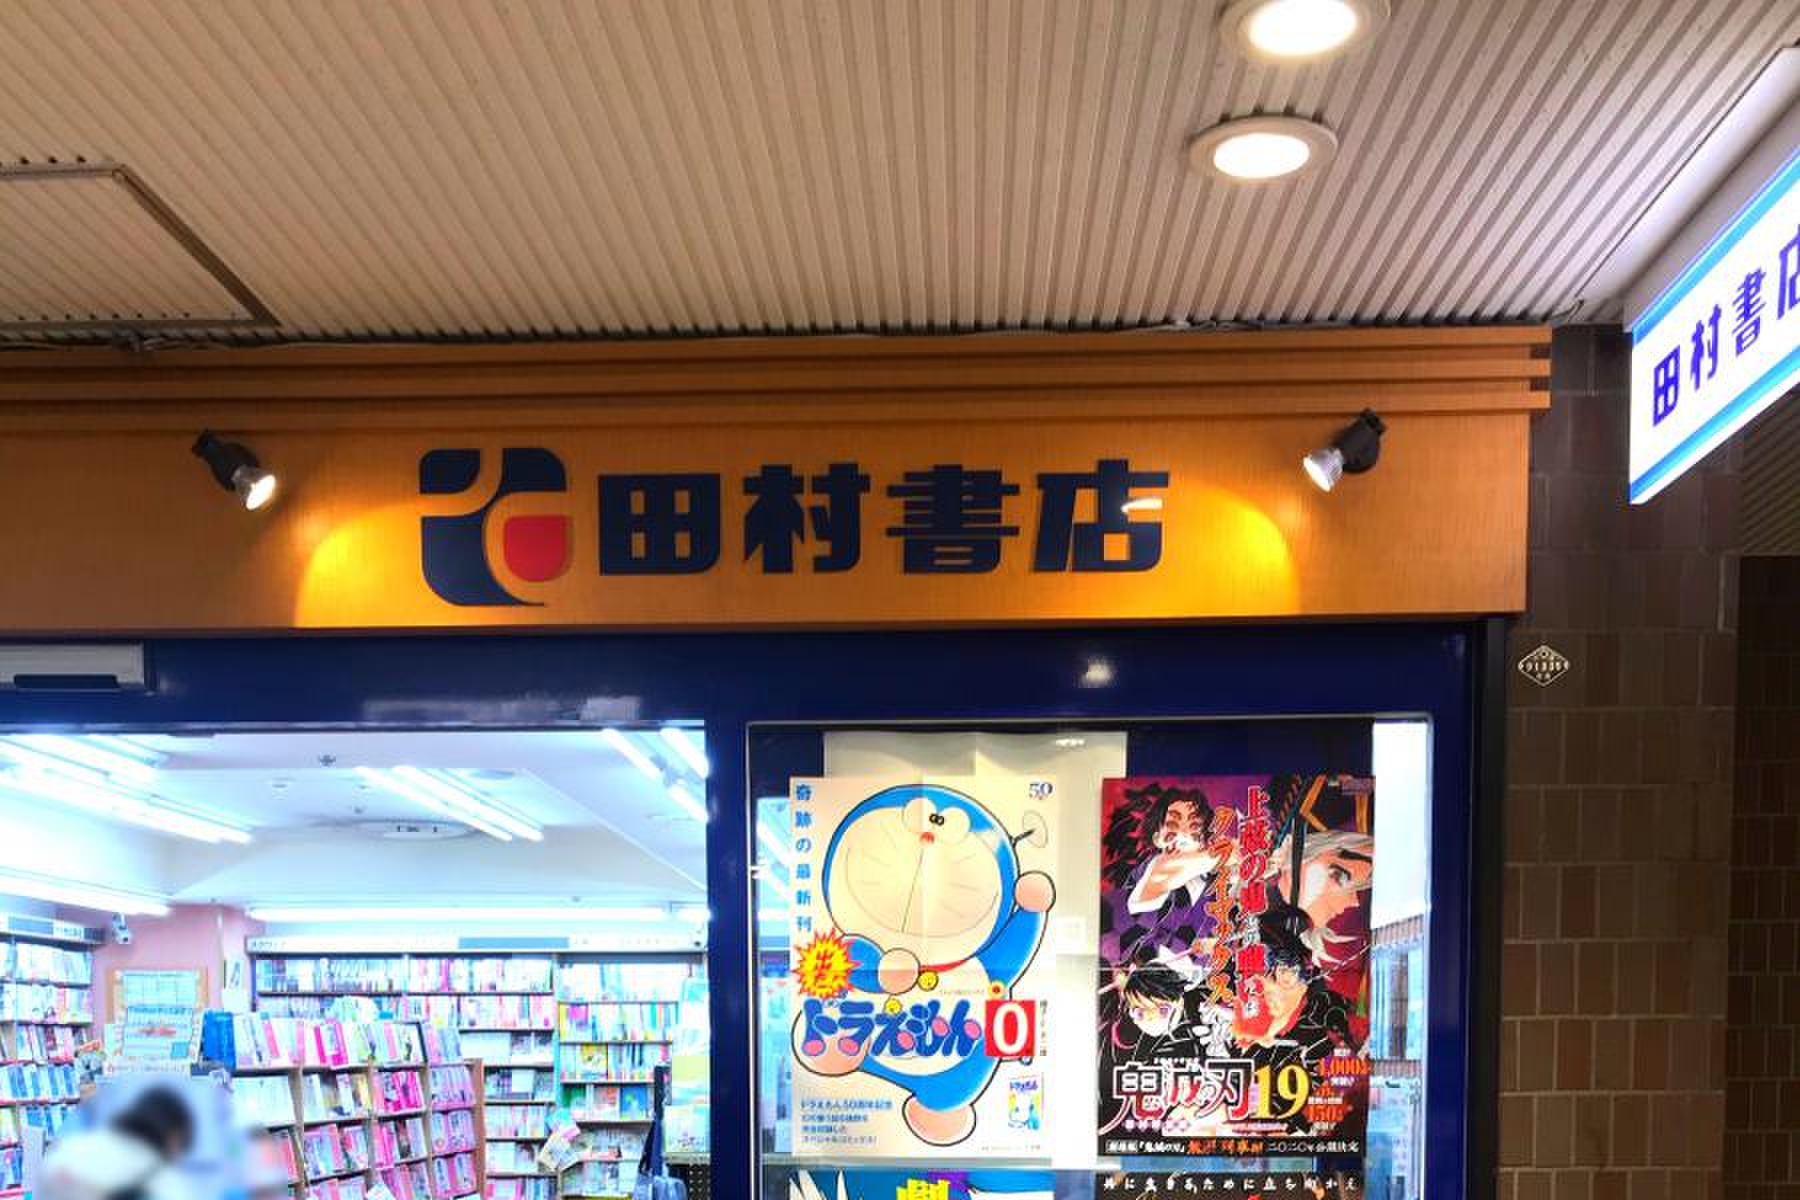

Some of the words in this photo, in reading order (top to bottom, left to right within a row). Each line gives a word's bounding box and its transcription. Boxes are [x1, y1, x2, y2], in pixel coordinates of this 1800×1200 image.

[598, 458, 1169, 577] 田村書店
[796, 783, 813, 934] 奇跡の最新刊
[801, 998, 983, 1057] ドラえもん
[1100, 1058, 1256, 1136] 鬼滅の刃
[1254, 1063, 1310, 1120] 19
